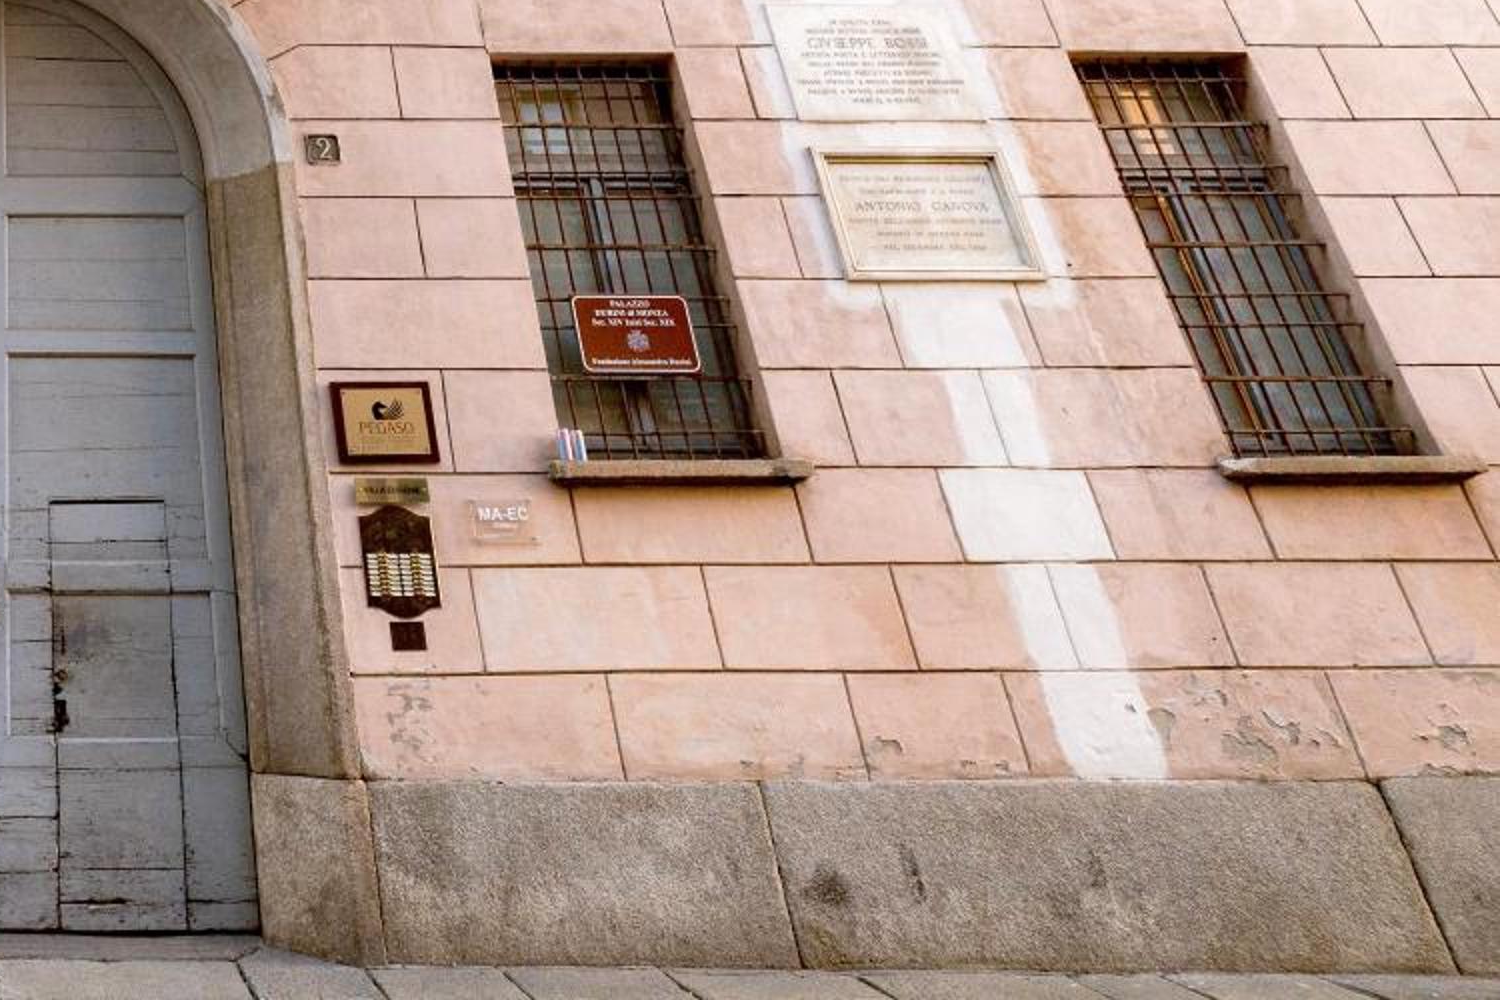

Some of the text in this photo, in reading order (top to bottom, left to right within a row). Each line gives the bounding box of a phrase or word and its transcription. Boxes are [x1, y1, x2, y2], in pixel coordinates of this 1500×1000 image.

[315, 137, 332, 159] 2
[855, 201, 989, 213] ANTONIO CANOVA
[358, 421, 415, 434] PEGASO
[477, 506, 529, 521] MA-EC
